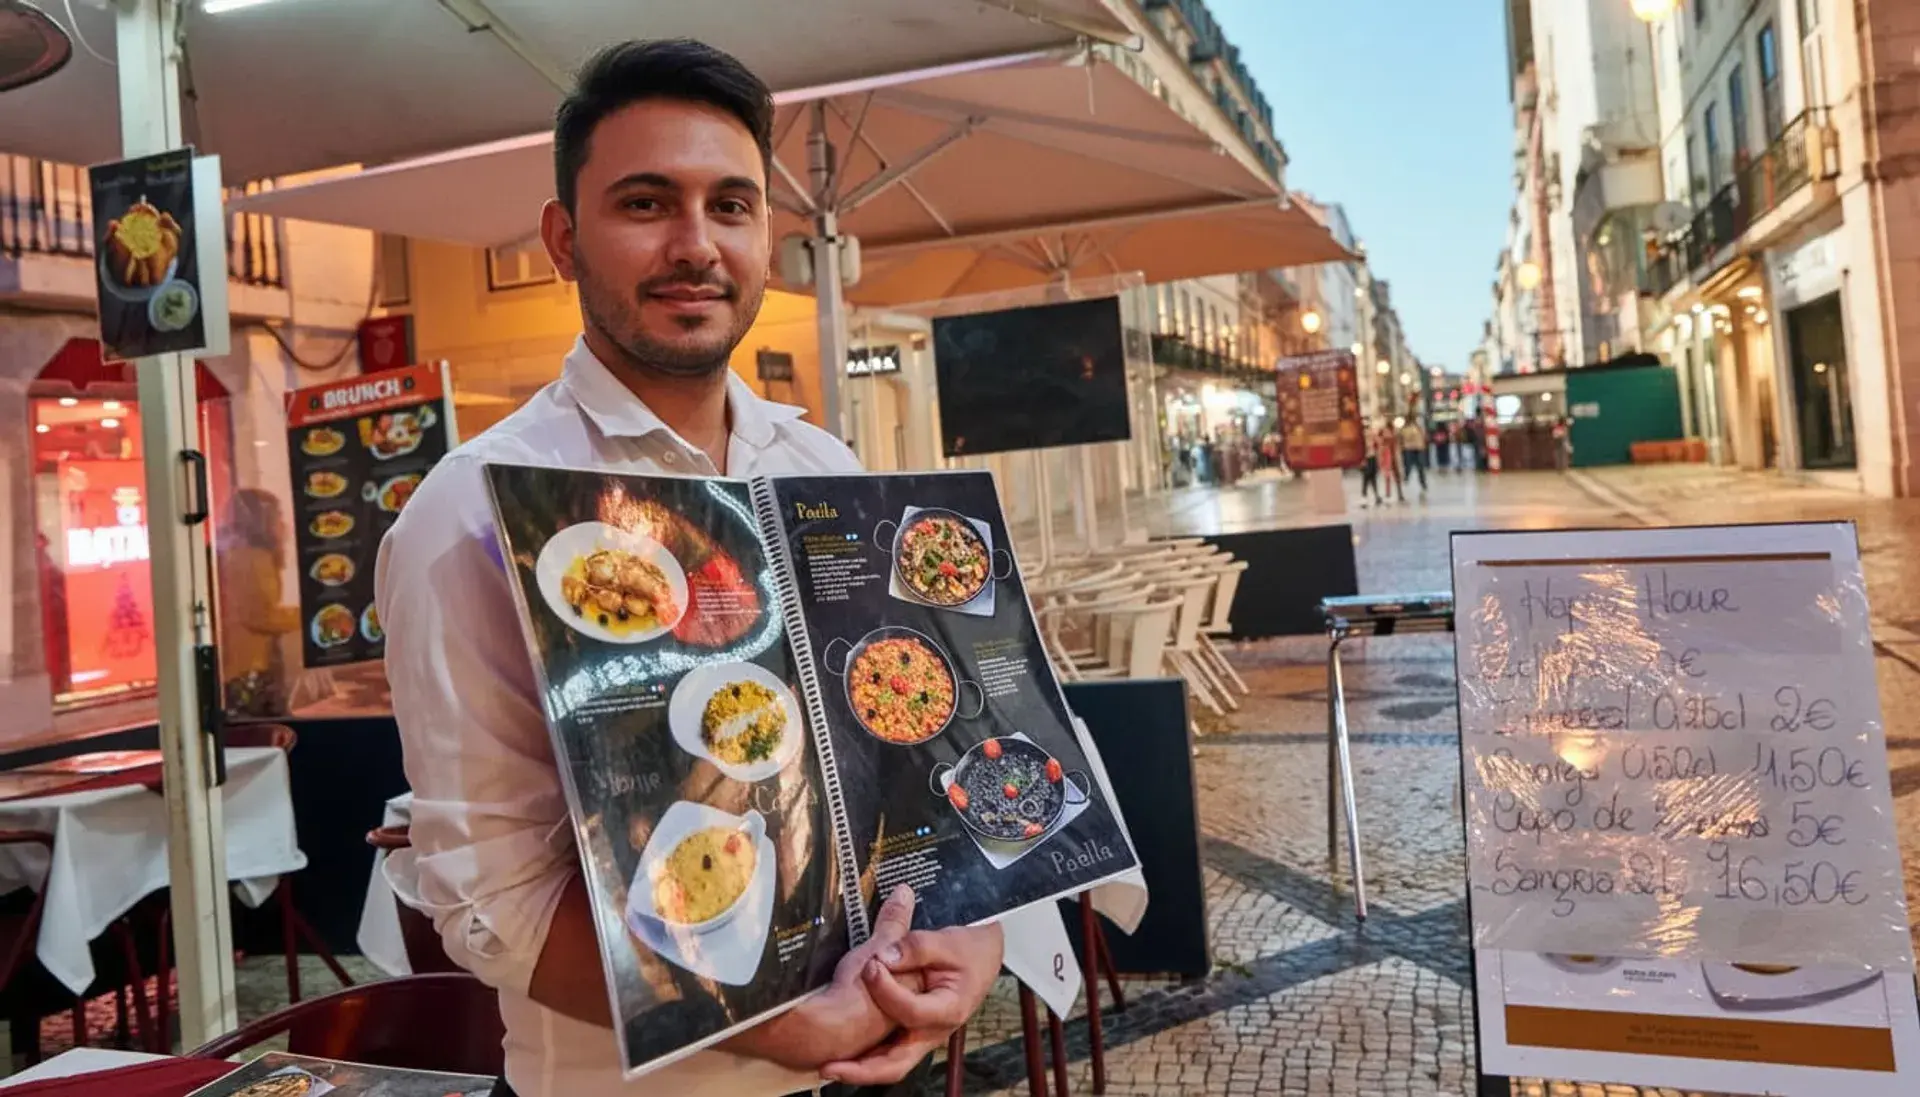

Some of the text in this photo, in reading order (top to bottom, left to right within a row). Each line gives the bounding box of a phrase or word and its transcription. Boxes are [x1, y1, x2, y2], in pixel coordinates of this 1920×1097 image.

[323, 377, 400, 409] BRUNCH
[1519, 576, 1628, 634] Hap
[1770, 685, 1836, 732] 2€
[1593, 788, 1636, 831] de
[1786, 801, 1846, 848] 5€
[1051, 838, 1115, 875] Paella
